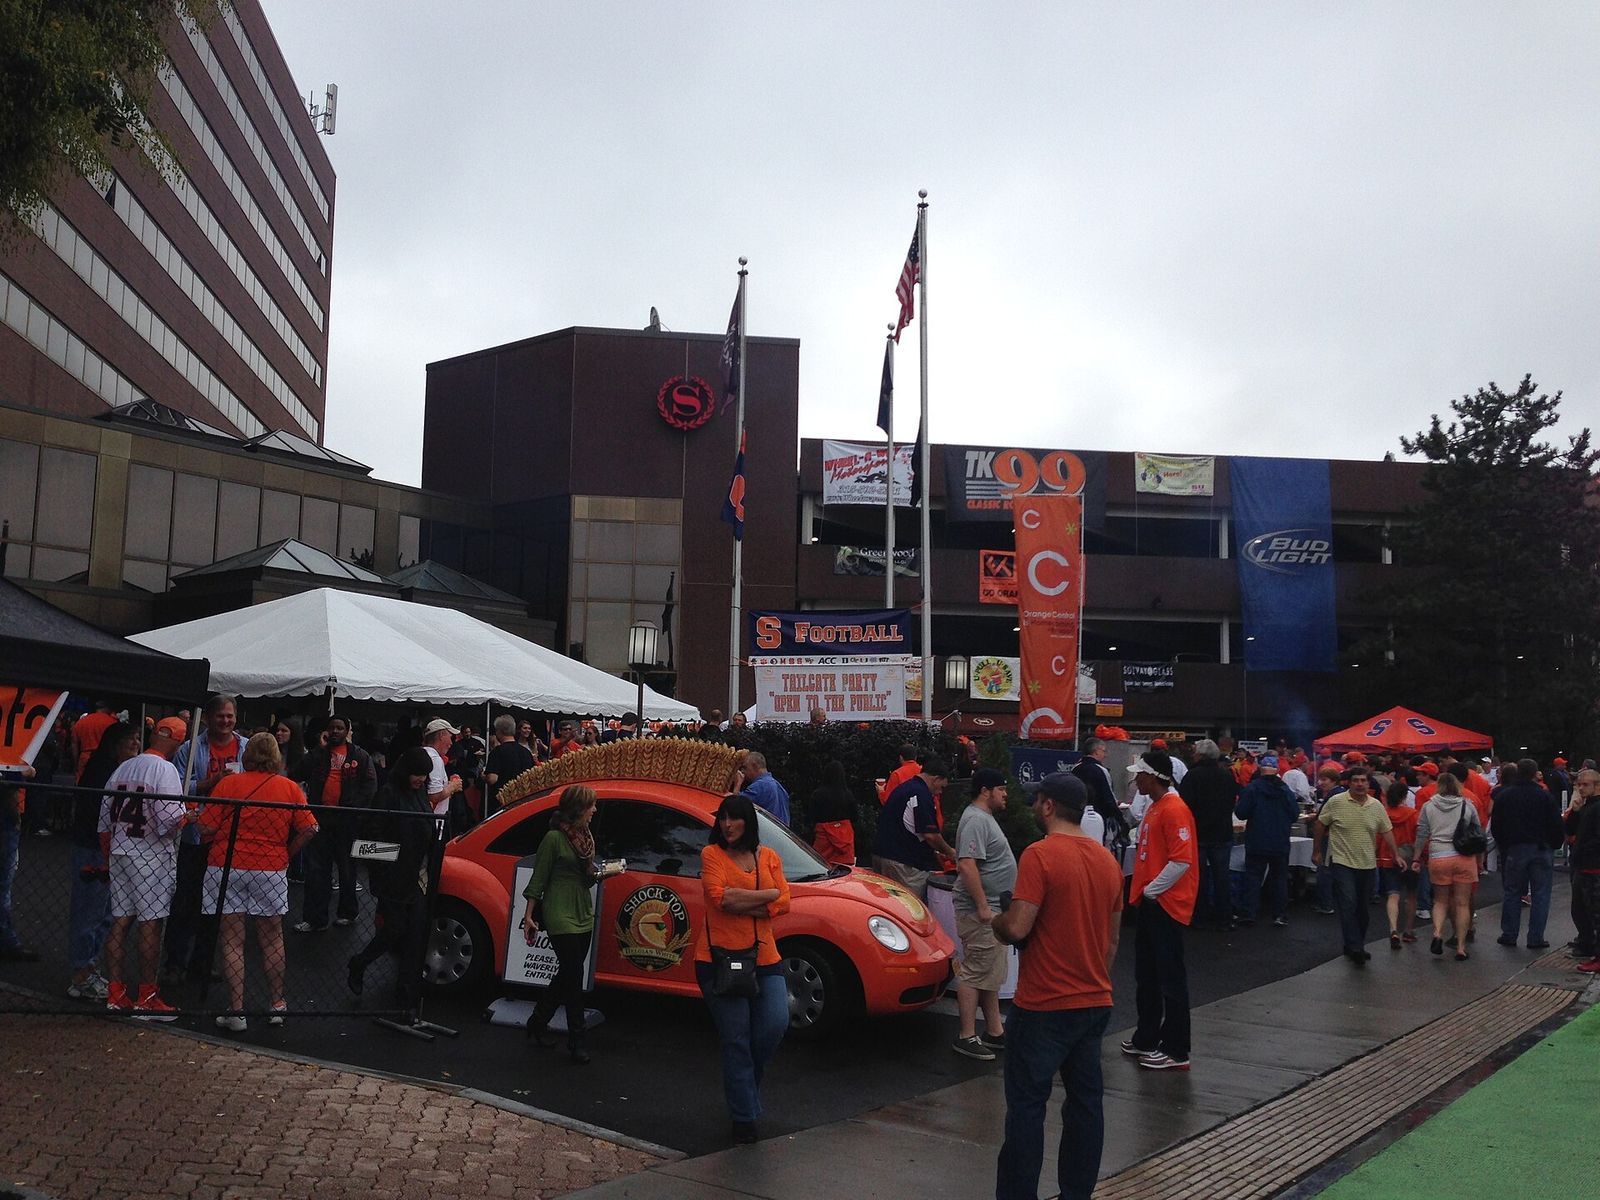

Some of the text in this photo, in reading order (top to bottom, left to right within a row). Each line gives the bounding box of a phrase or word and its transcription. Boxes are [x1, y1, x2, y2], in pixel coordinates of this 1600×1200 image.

[672, 384, 702, 417] S
[966, 499, 1001, 510] CLASSIC
[1268, 537, 1330, 552] BUD
[1255, 550, 1332, 564] LIGHT
[756, 616, 782, 649] S
[817, 657, 838, 665] ACC
[782, 673, 877, 692] TAILGATE PARTY
[805, 694, 819, 712] TO
[824, 694, 845, 712] THE
[668, 893, 686, 921] TOP
[525, 953, 556, 964] PLEASE
